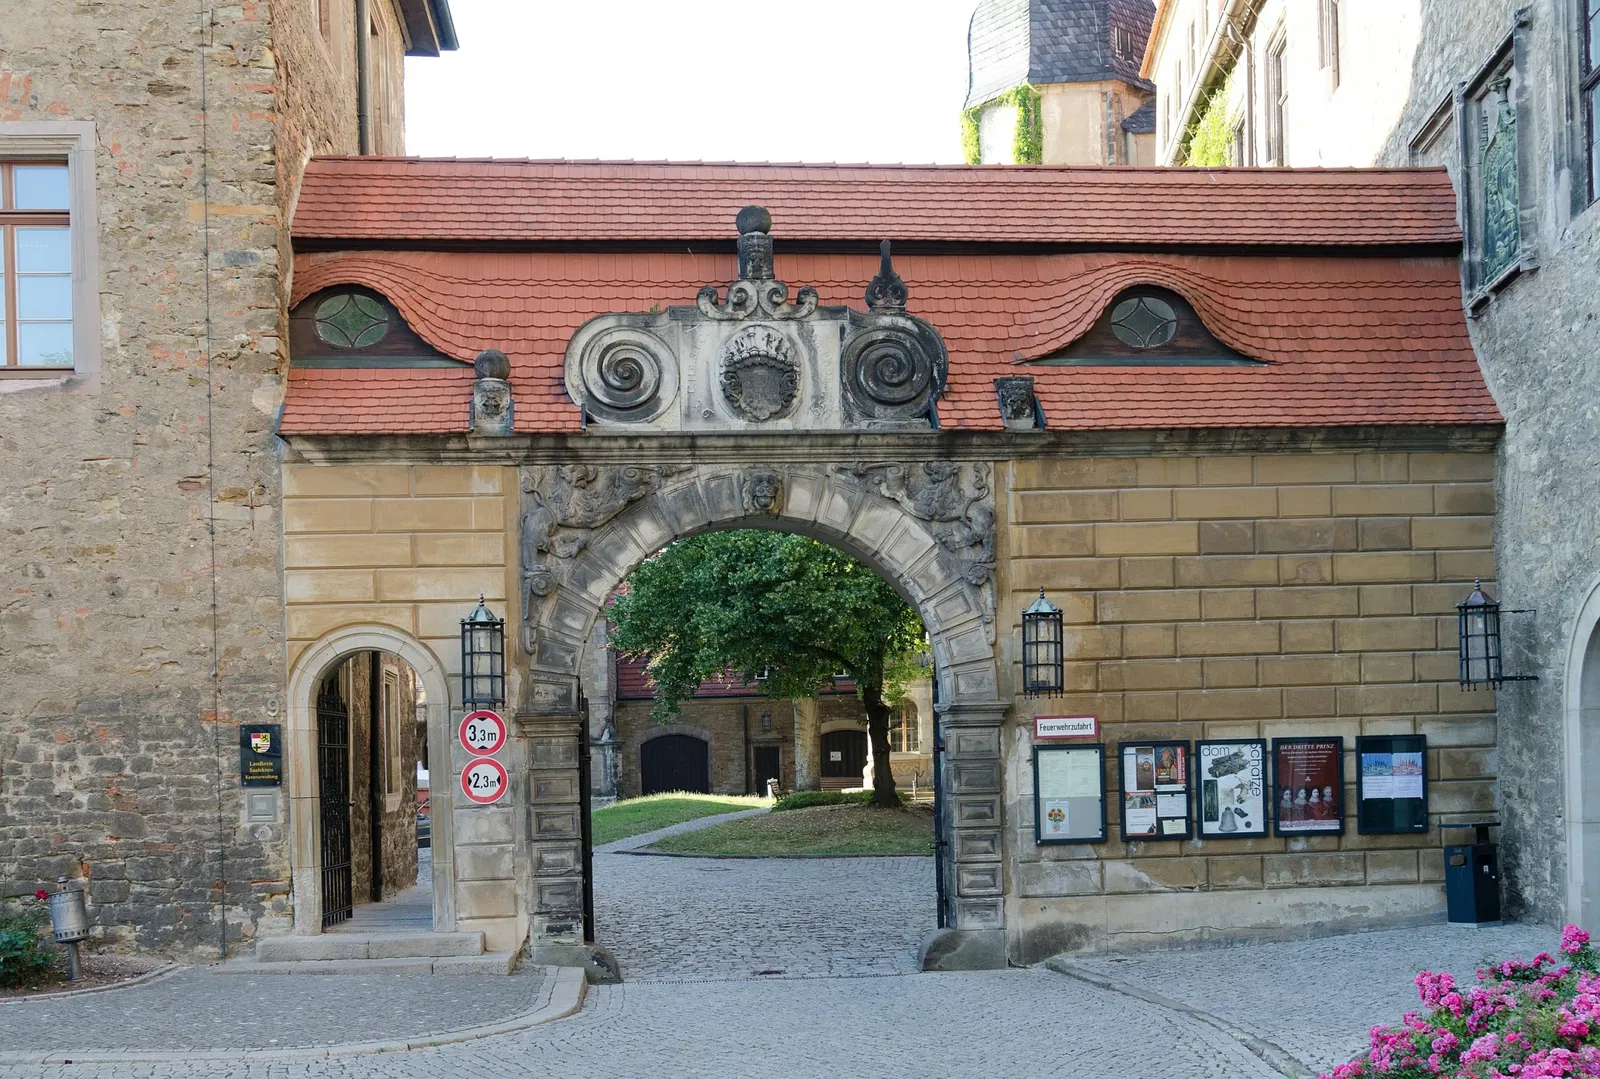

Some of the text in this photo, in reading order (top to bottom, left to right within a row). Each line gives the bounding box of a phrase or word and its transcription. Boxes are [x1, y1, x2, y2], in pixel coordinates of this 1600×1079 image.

[266, 698, 280, 717] 9
[1039, 722, 1092, 733] Feuerwehrzufahrt
[1202, 745, 1230, 757] dom
